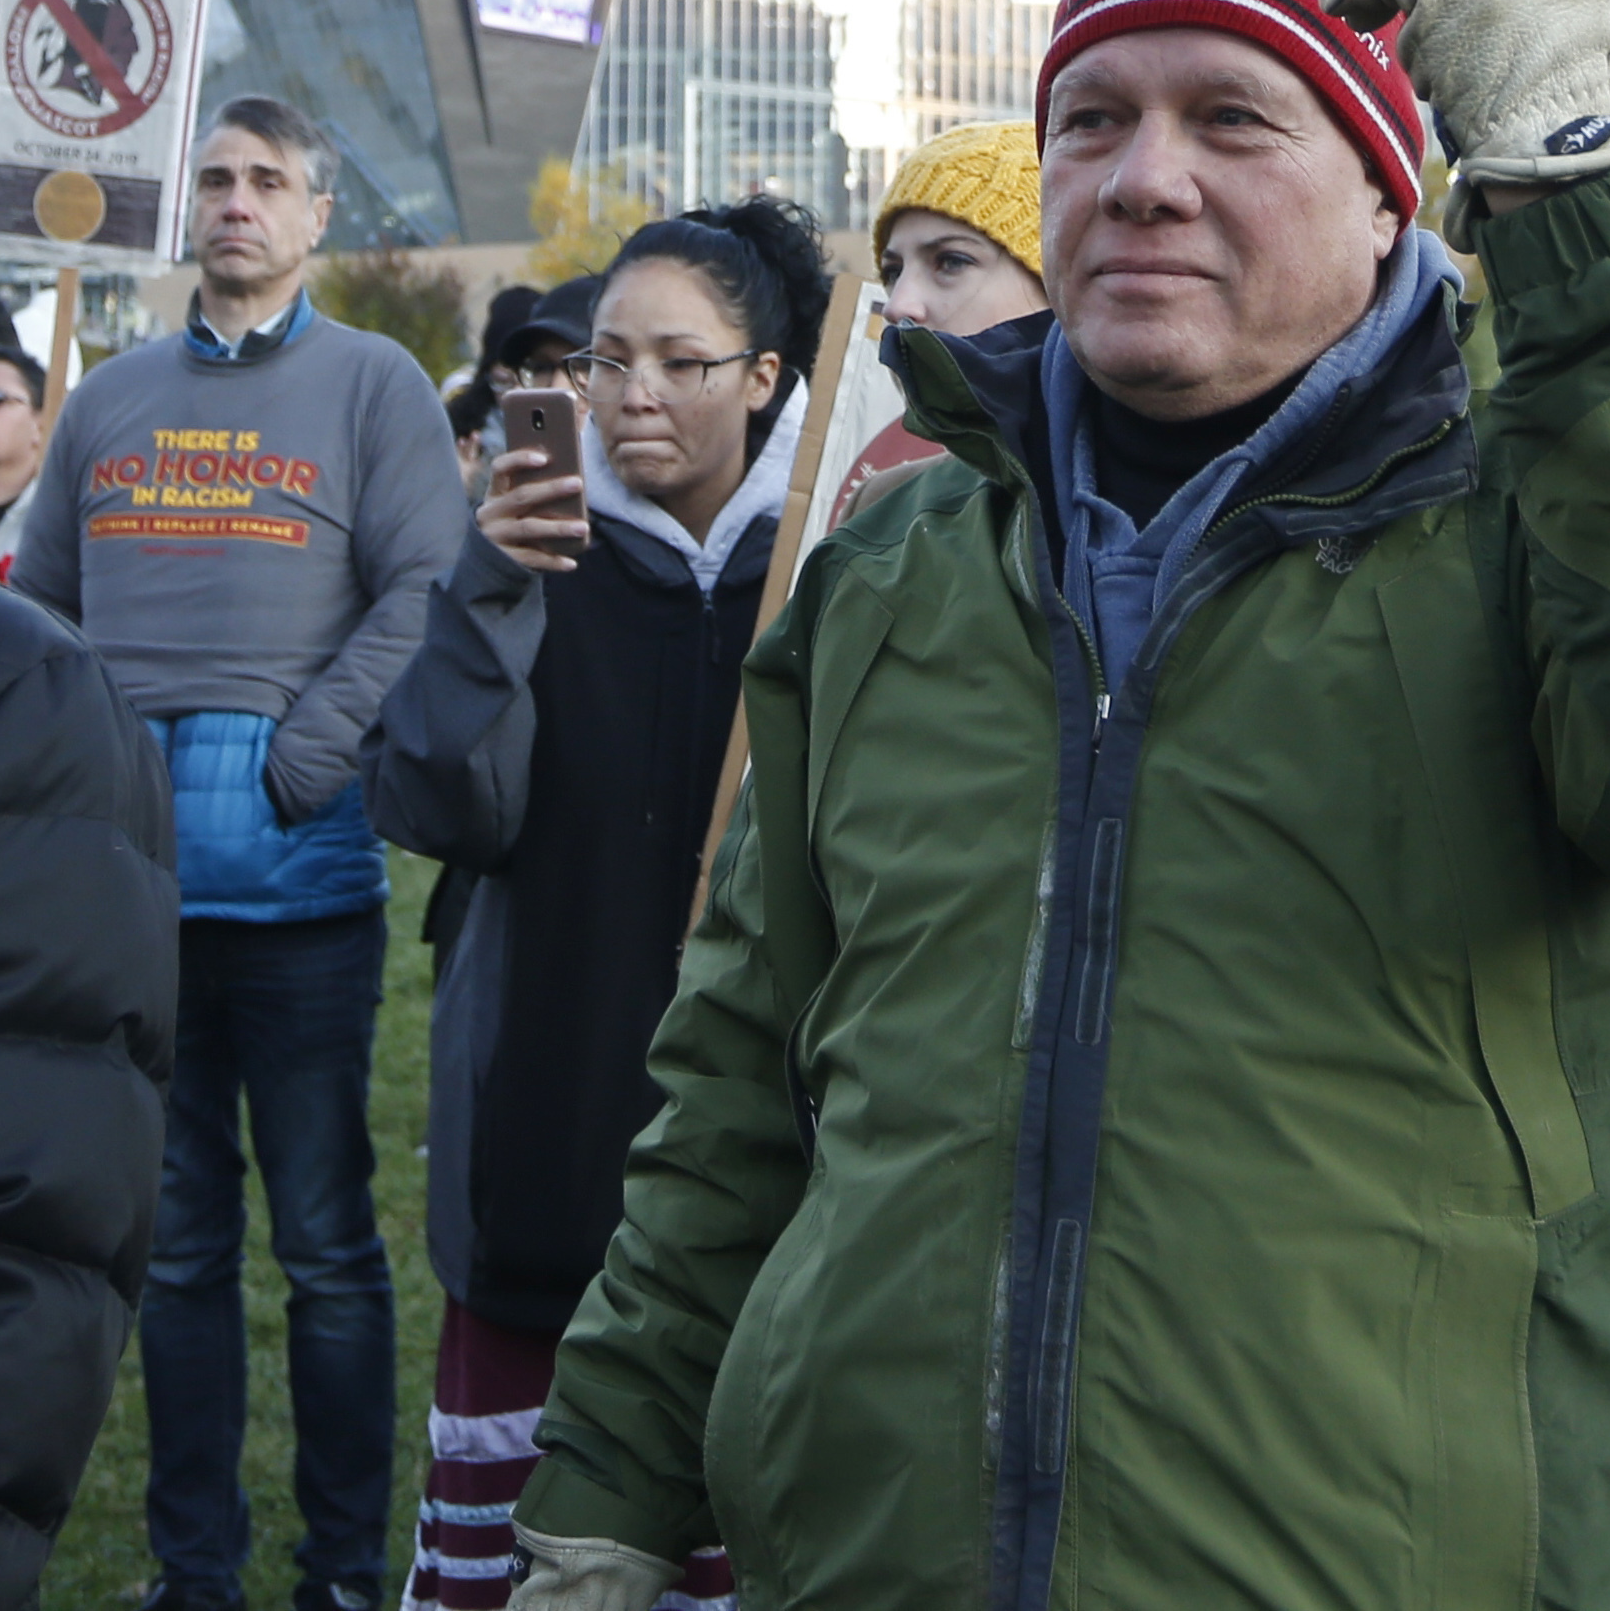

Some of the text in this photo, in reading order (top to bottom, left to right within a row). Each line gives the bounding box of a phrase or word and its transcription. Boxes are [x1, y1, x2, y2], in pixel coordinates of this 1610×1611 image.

[13, 140, 81, 161] OCTOBER
[153, 428, 261, 451] THERE IS
[90, 452, 319, 497] NO HONOR
[132, 486, 254, 508] IN RACISM
